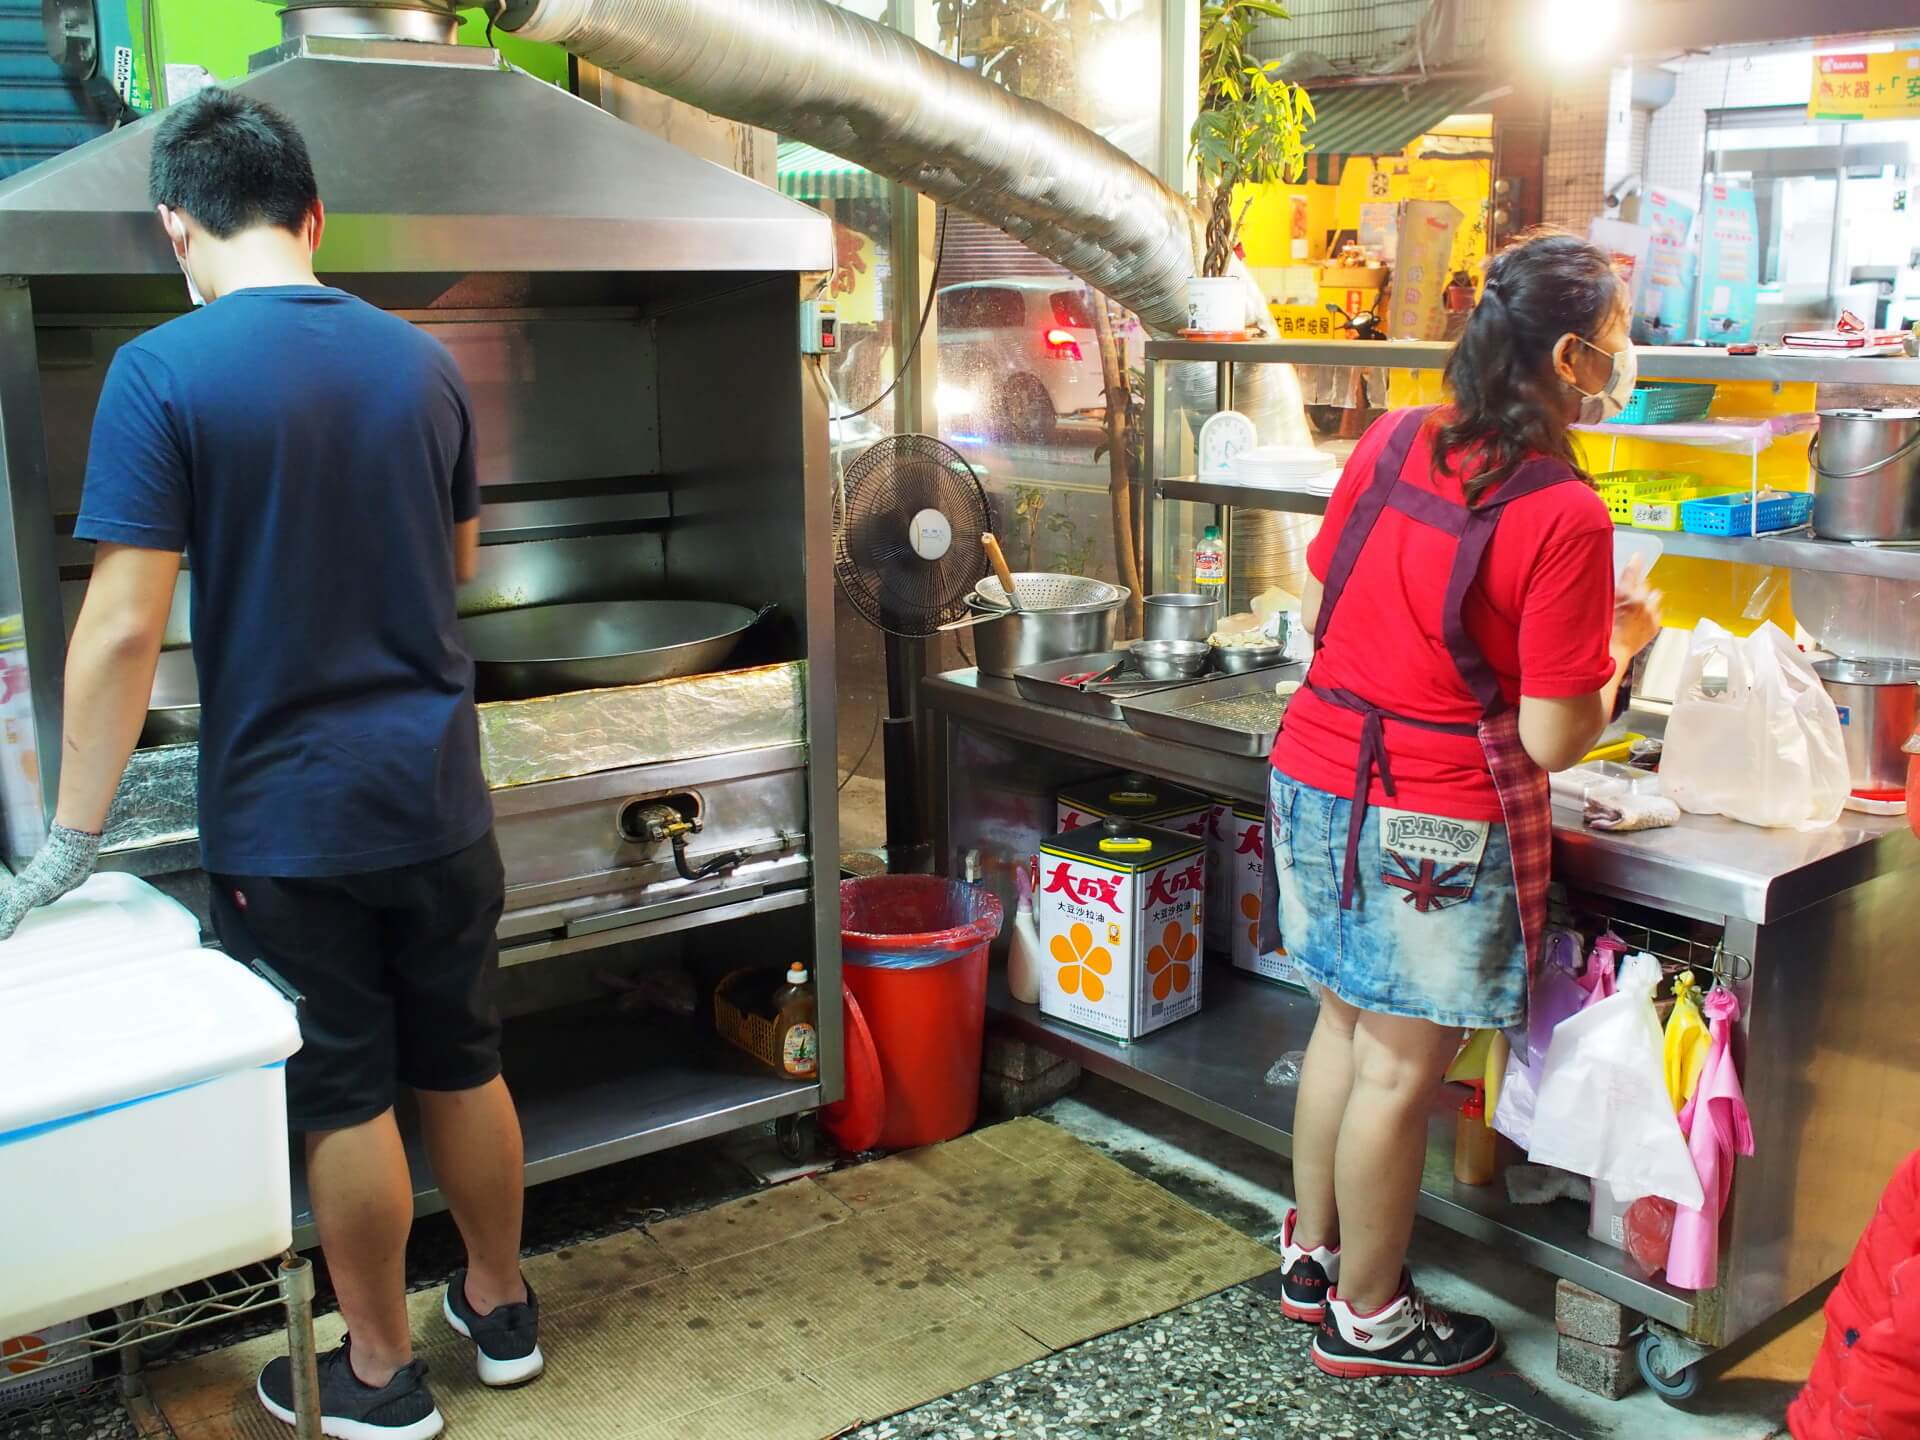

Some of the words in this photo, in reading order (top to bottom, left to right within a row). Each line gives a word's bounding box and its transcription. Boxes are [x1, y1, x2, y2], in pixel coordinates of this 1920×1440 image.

[1387, 815, 1480, 852] JEANS
[1042, 861, 1126, 914] 大成
[1142, 857, 1206, 911] 大成
[1057, 901, 1105, 923] 大豆沙拉油
[1152, 900, 1192, 922] 大豆沙拉油
